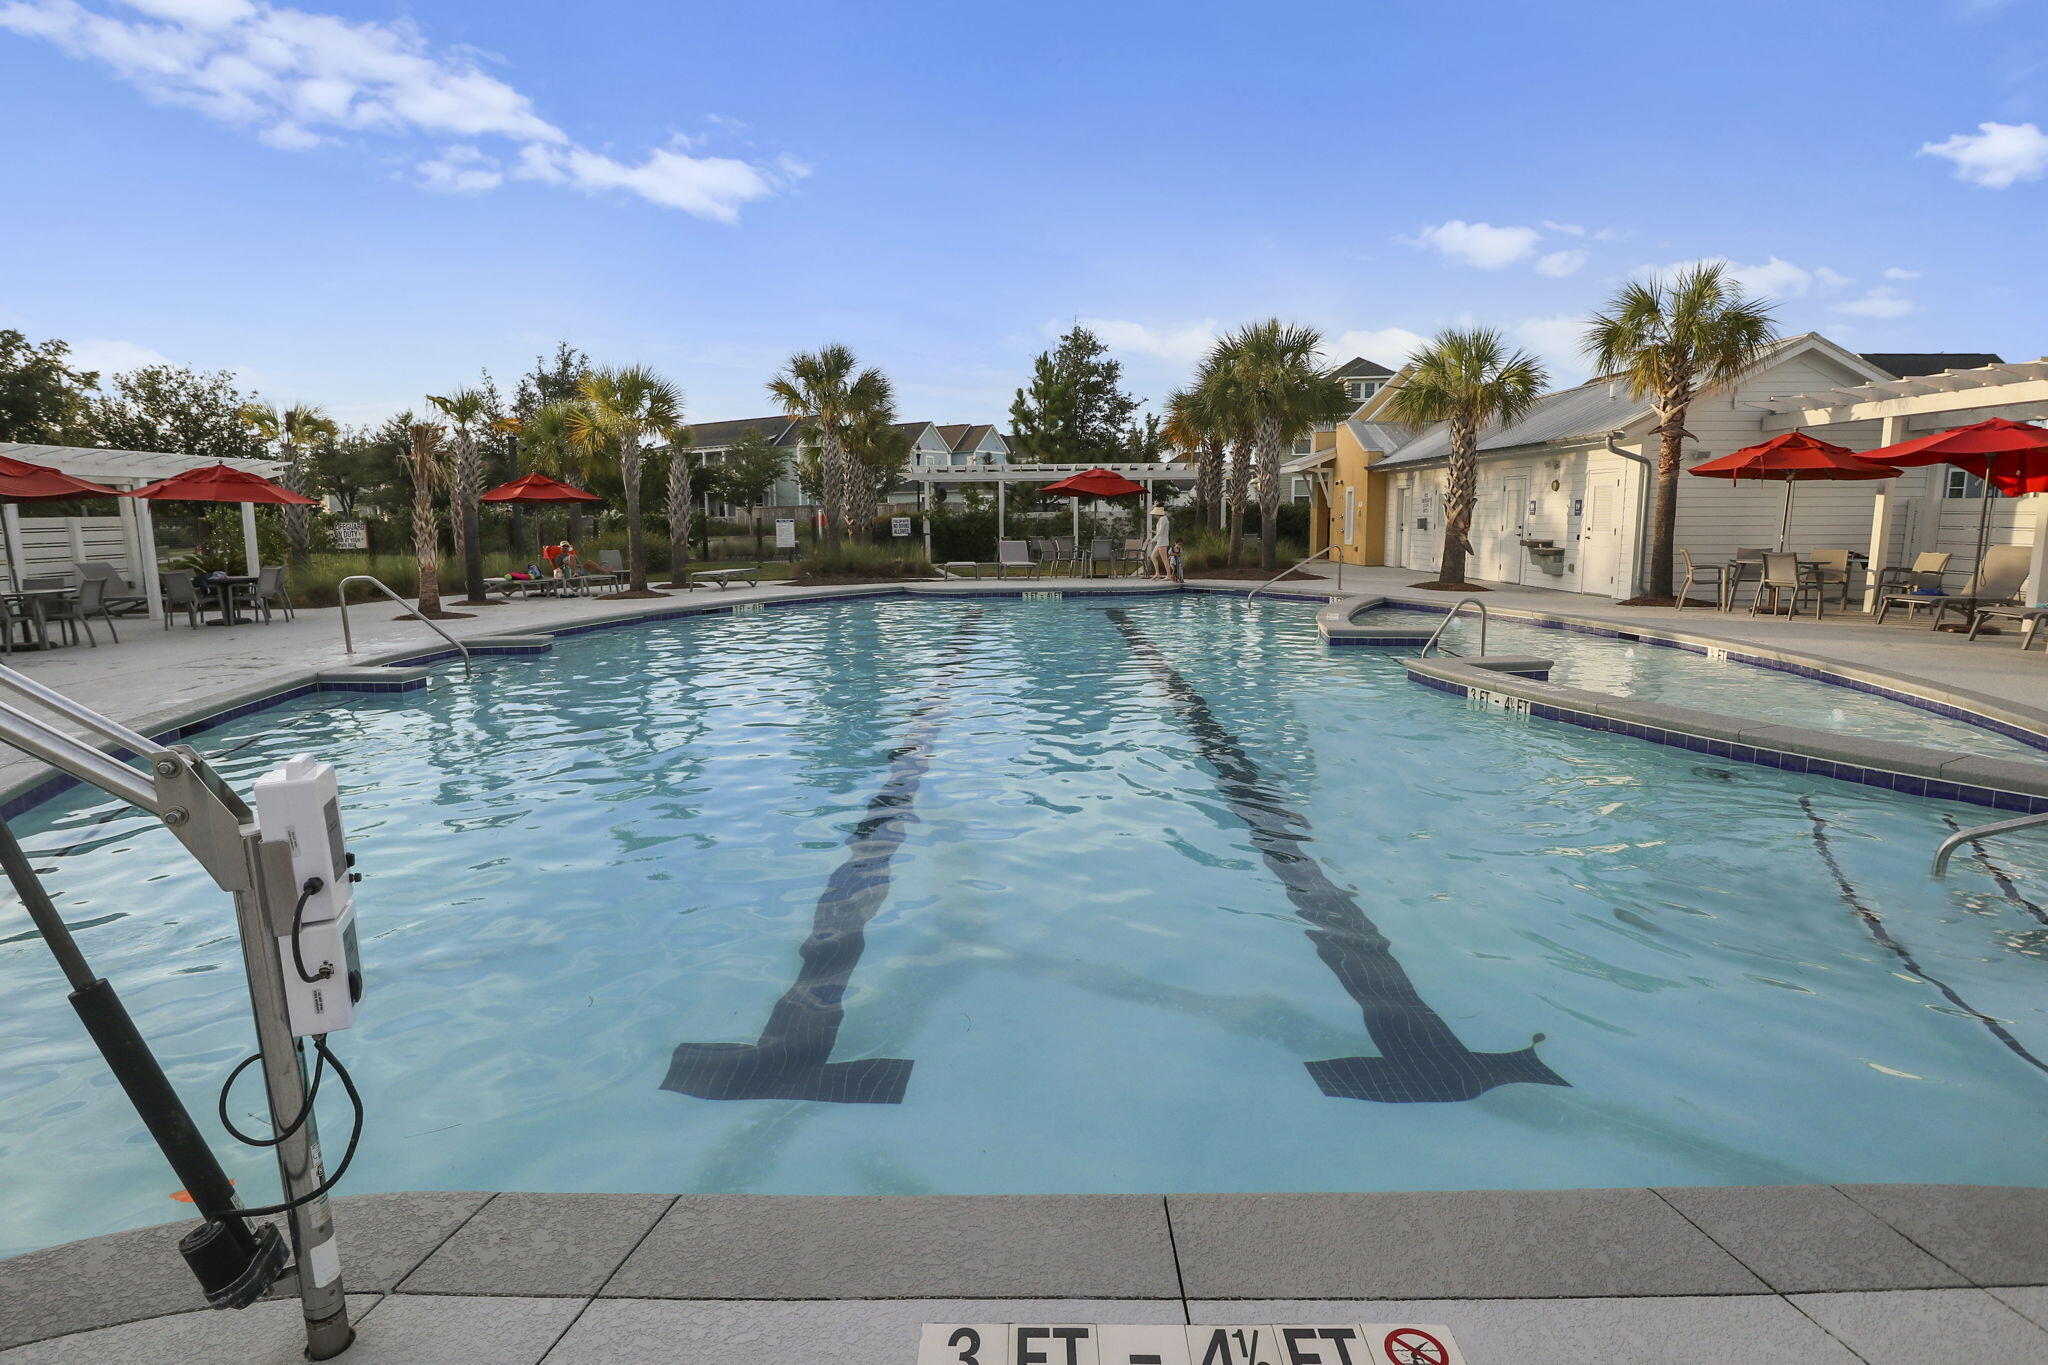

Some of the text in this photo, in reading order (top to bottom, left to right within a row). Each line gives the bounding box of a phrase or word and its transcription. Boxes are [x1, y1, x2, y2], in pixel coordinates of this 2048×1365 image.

[1517, 698, 1530, 714] FT
[947, 1327, 981, 1365] 3
[1017, 1327, 1089, 1365] FT
[1282, 1328, 1356, 1365] FT
